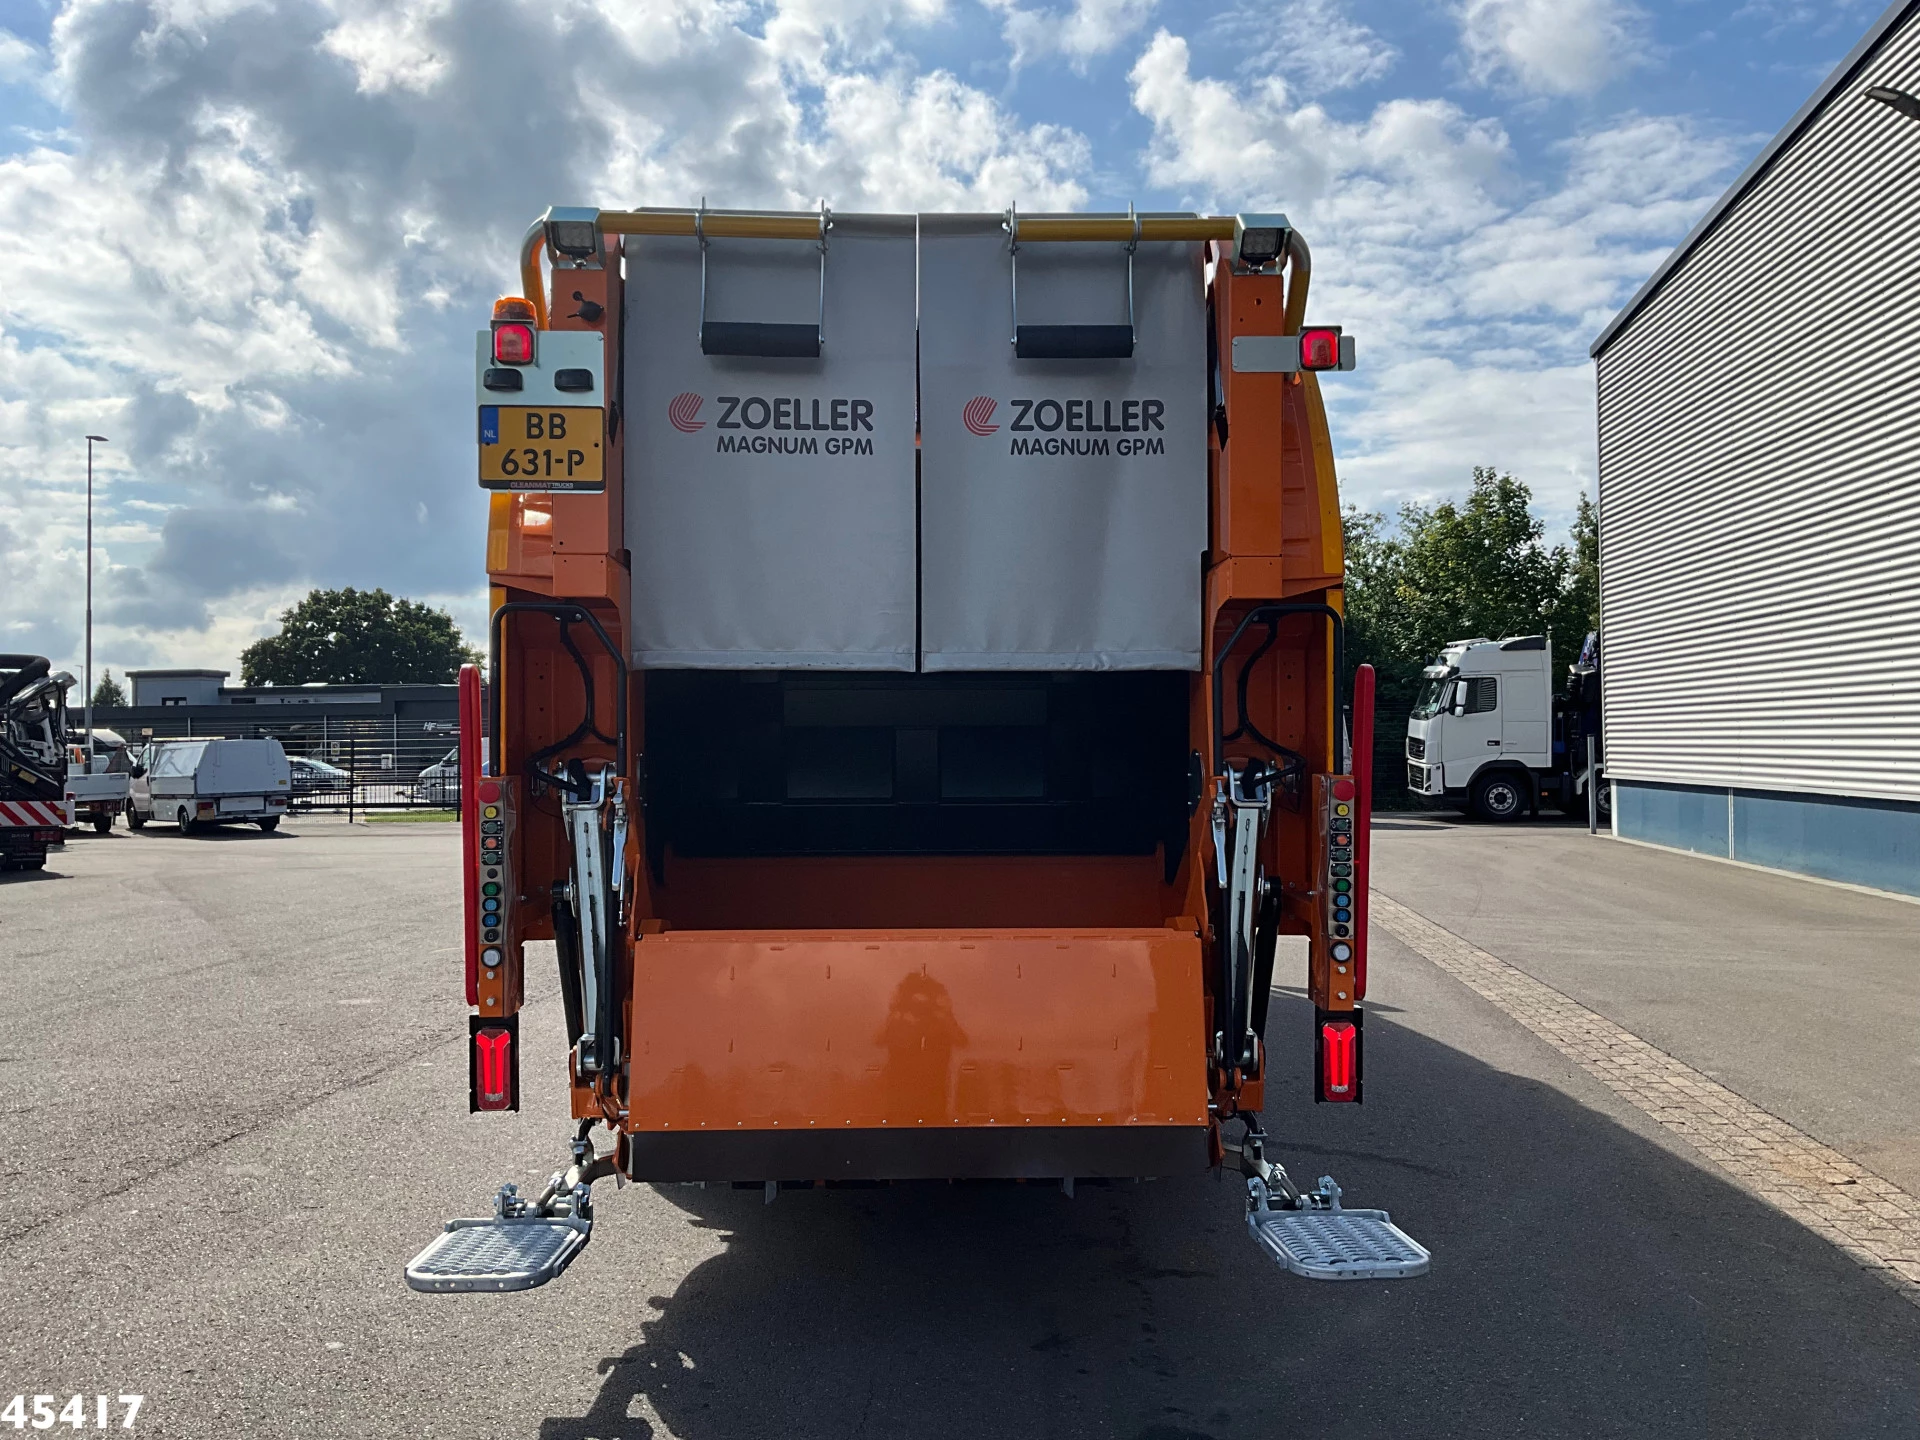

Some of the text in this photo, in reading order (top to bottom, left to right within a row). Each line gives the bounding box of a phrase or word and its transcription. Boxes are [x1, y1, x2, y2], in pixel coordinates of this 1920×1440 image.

[526, 412, 567, 440] BB
[716, 396, 874, 432] ZOELLER
[1010, 398, 1165, 432] ZOELLER
[484, 429, 497, 439] NL
[716, 435, 874, 456] MAGNUM GPM
[1010, 437, 1165, 456] MAGNUM GPM
[500, 448, 585, 477] 631-P
[510, 481, 551, 489] CLEANMAT
